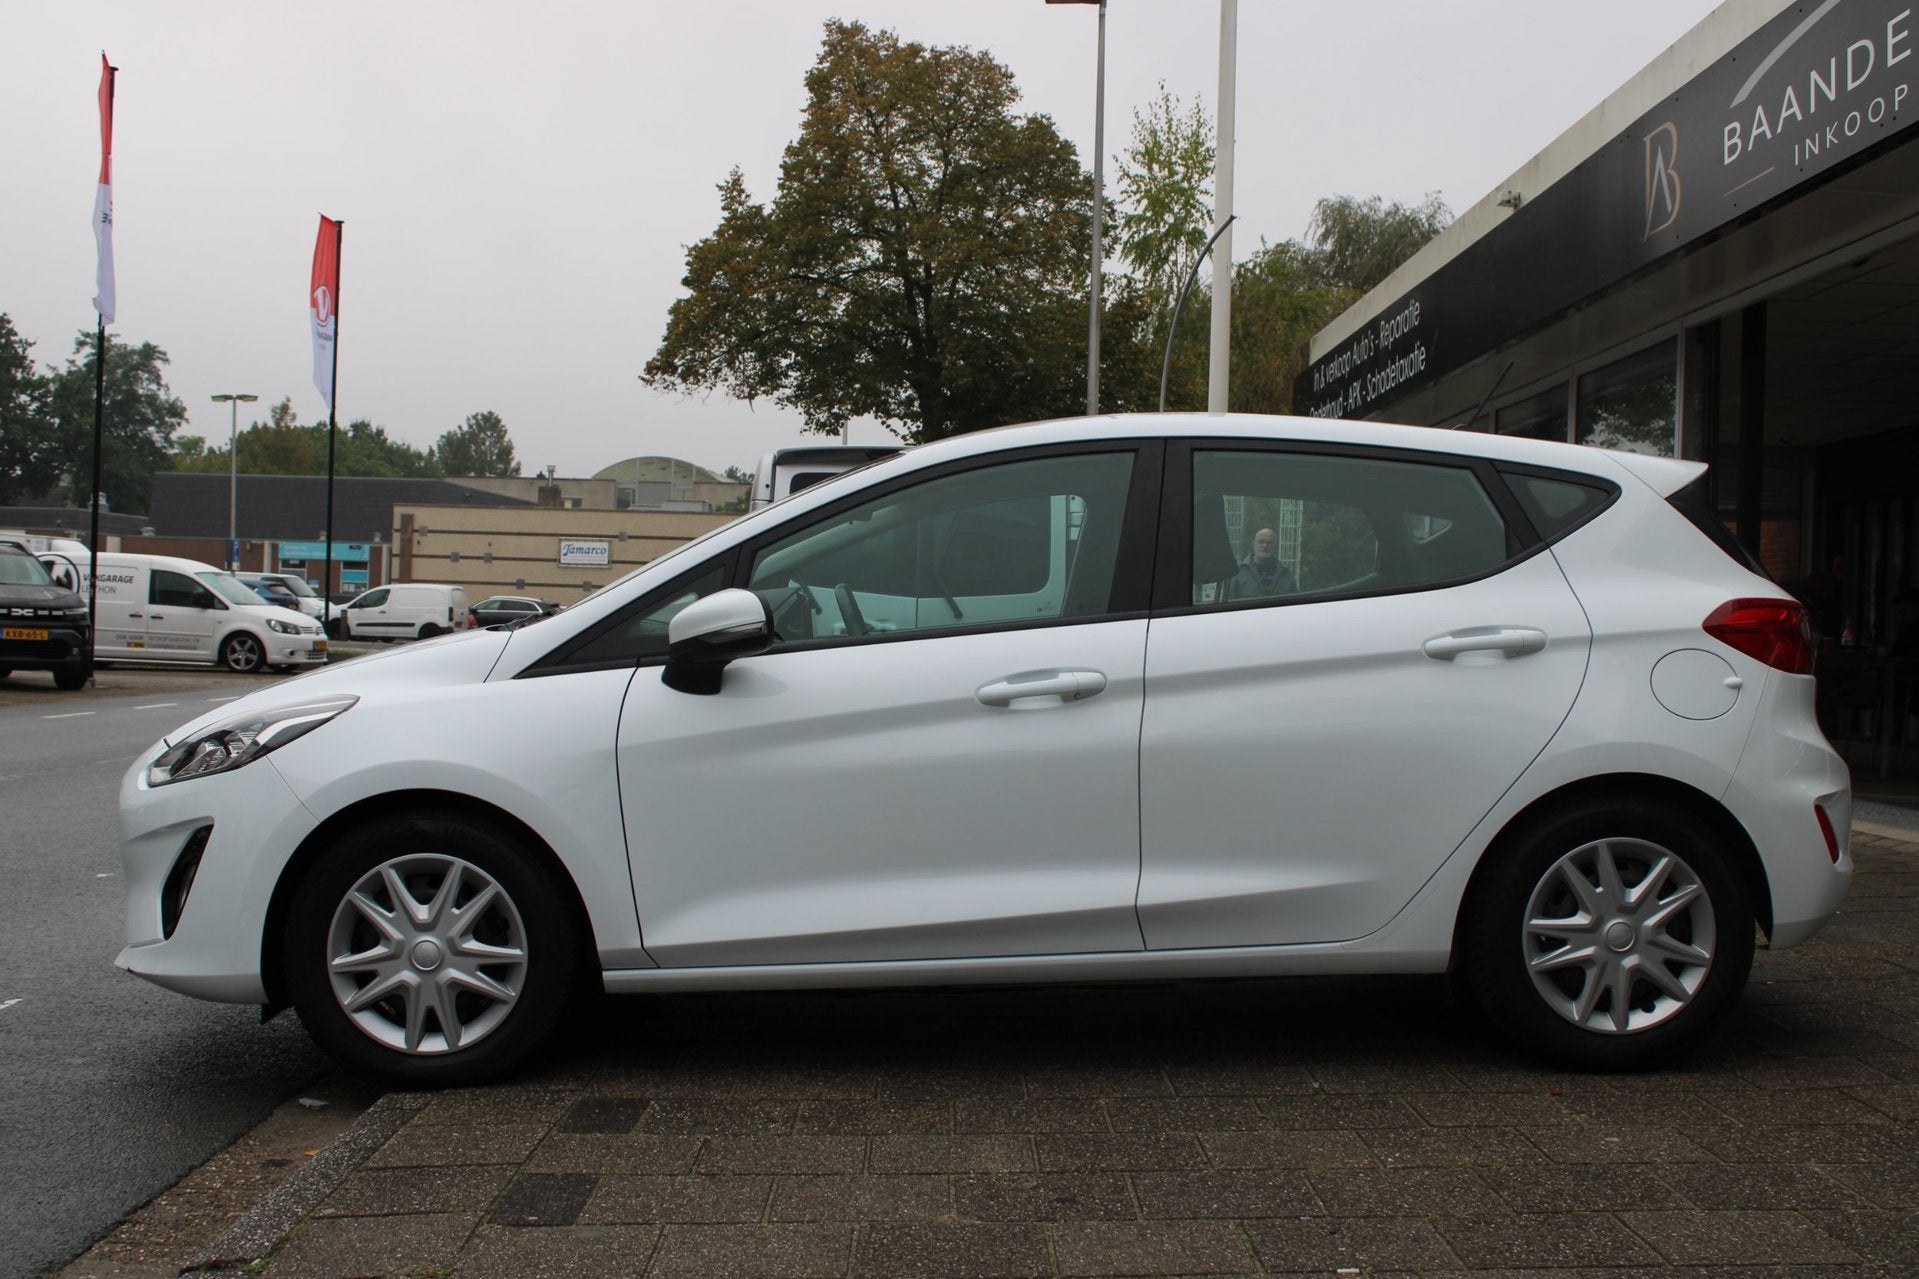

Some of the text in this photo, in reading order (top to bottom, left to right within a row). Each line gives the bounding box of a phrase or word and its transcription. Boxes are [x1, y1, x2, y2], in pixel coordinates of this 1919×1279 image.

[1794, 84, 1908, 166] INKOOP
[1325, 351, 1350, 383] verkoop
[1352, 330, 1374, 368] Auto's
[1379, 299, 1420, 350] Reparatie
[1347, 378, 1362, 412] APK
[1366, 341, 1426, 402] Schadetaxatie
[83, 573, 134, 584] VKGARAGE
[563, 543, 607, 557] Tamarco
